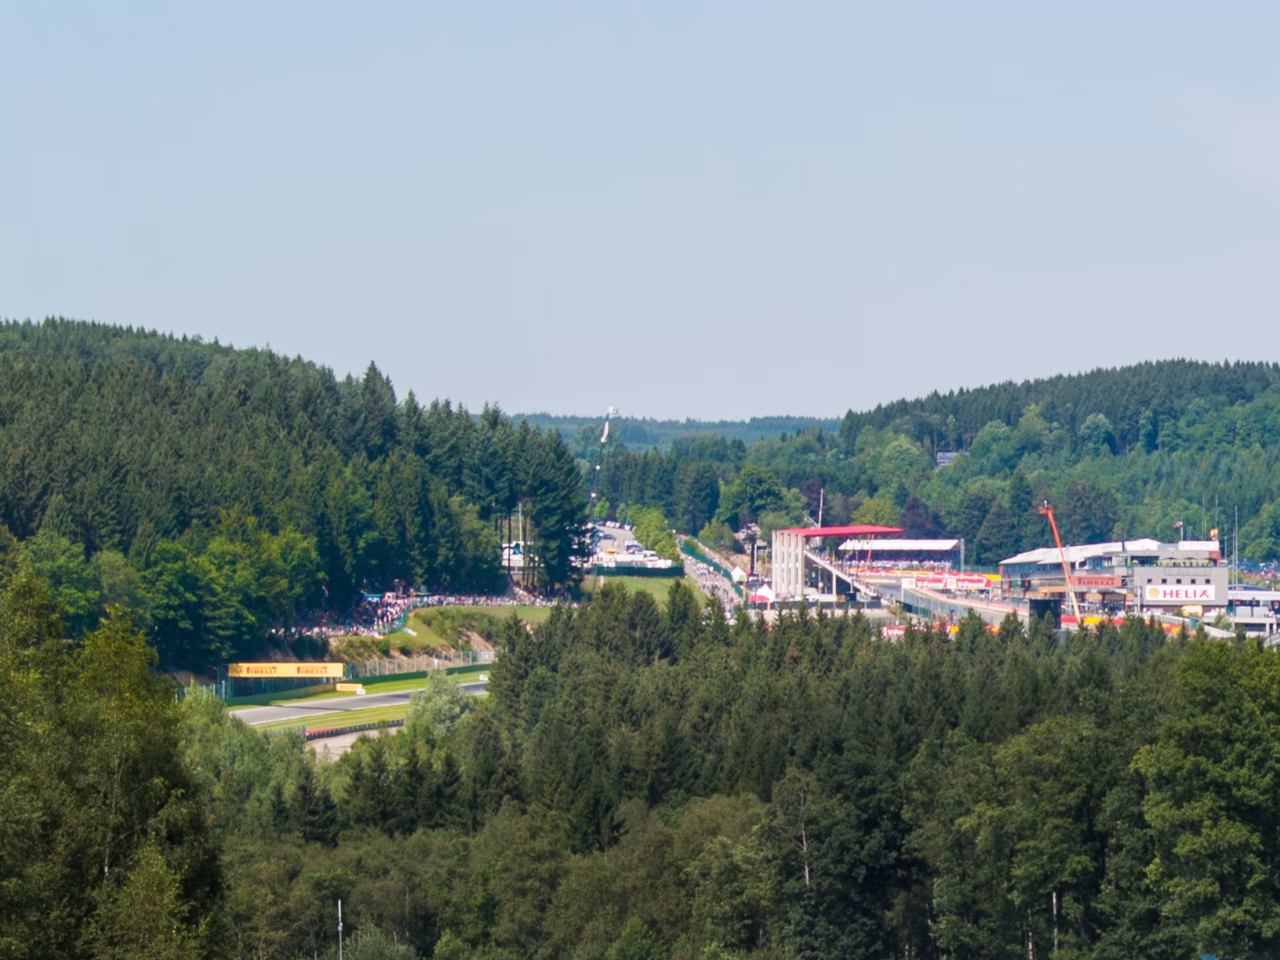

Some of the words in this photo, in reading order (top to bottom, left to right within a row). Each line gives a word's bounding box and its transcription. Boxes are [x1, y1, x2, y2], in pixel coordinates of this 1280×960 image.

[1077, 577, 1115, 586] PIRELLI
[1163, 589, 1209, 598] HELIX
[246, 666, 277, 674] PIRELLI
[297, 666, 328, 674] PIRELLI
